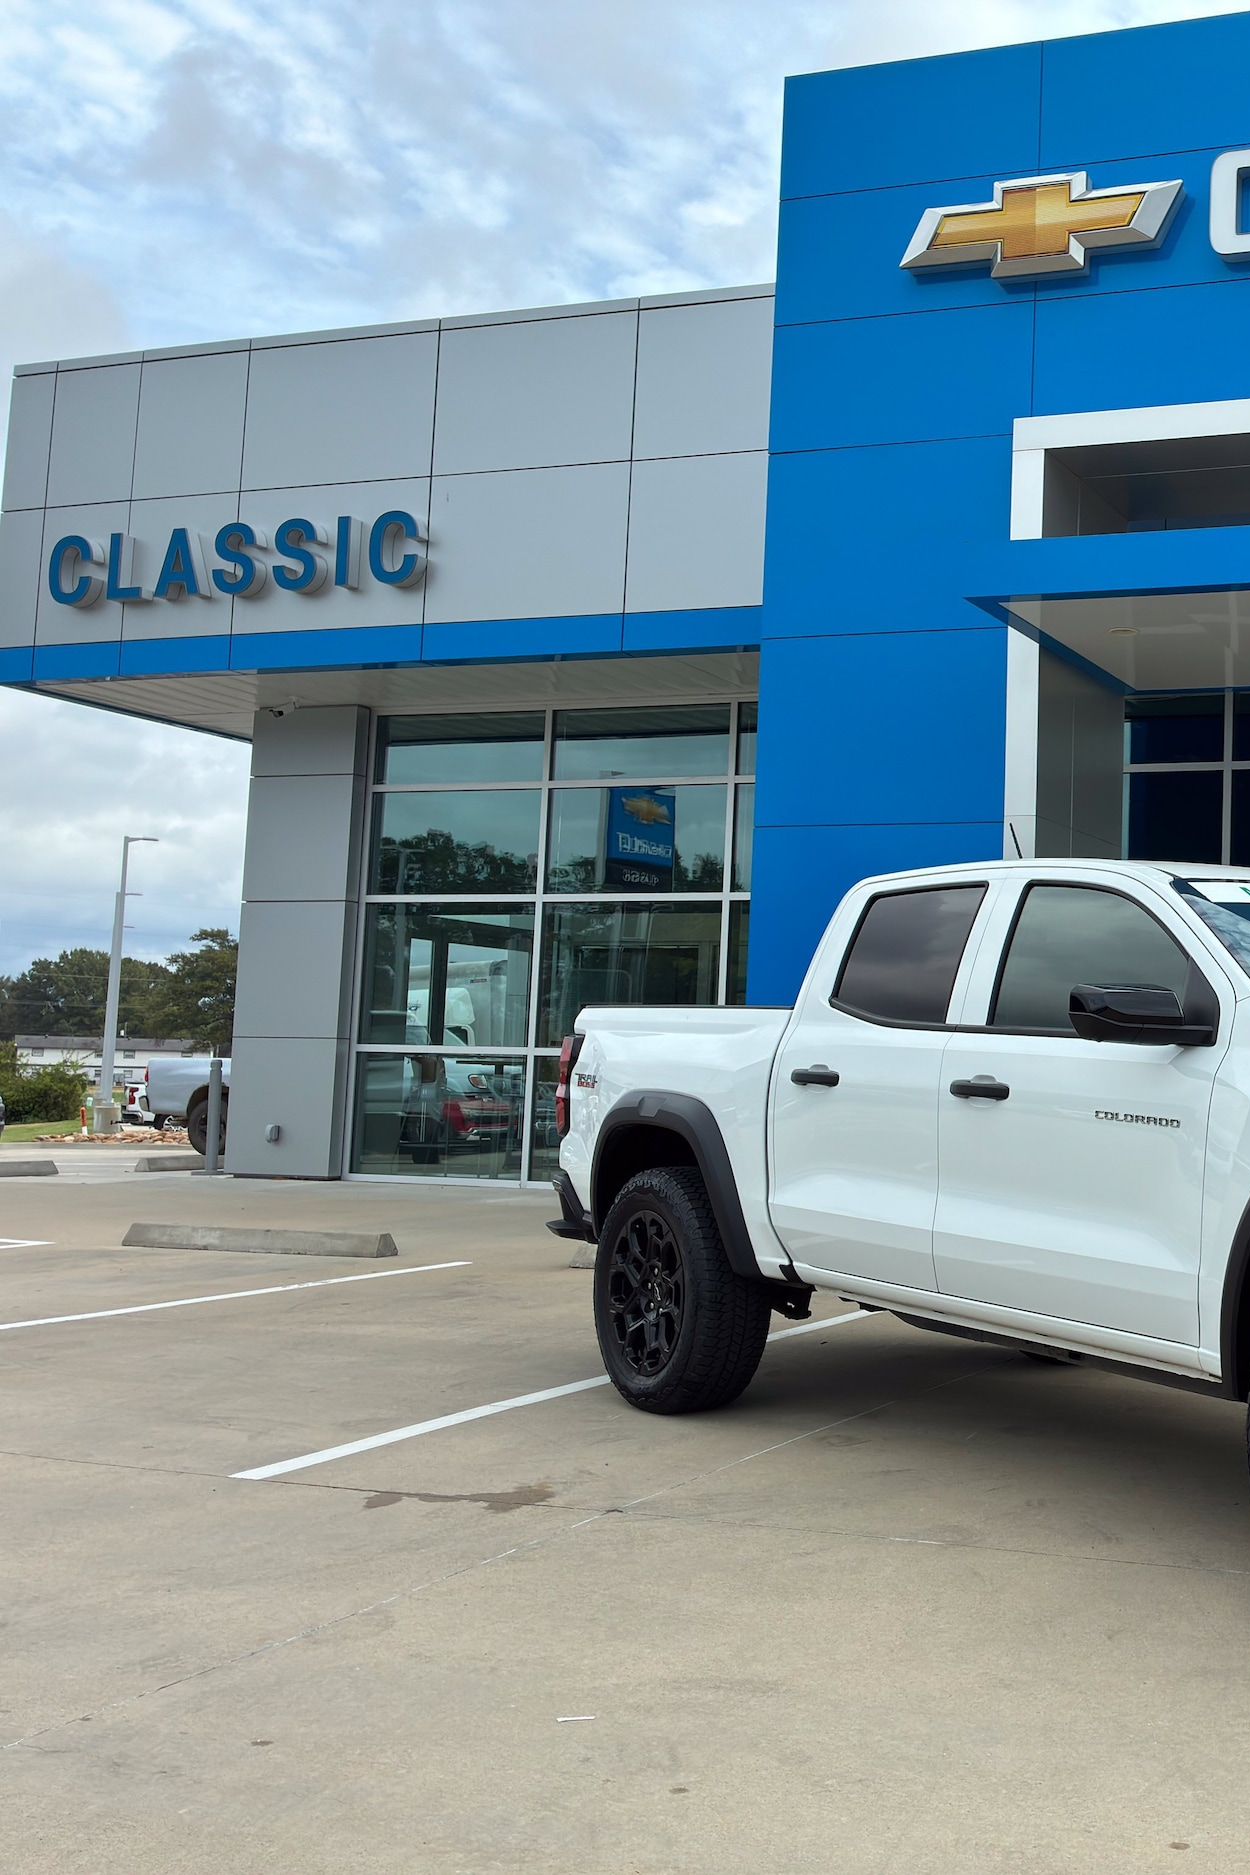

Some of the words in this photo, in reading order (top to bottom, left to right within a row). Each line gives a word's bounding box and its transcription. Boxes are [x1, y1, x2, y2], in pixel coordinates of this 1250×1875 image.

[47, 509, 428, 607] CLASSIC
[575, 1073, 598, 1083] TRAIL
[577, 1080, 595, 1089] BOSS
[1094, 1110, 1181, 1129] COLORADO
